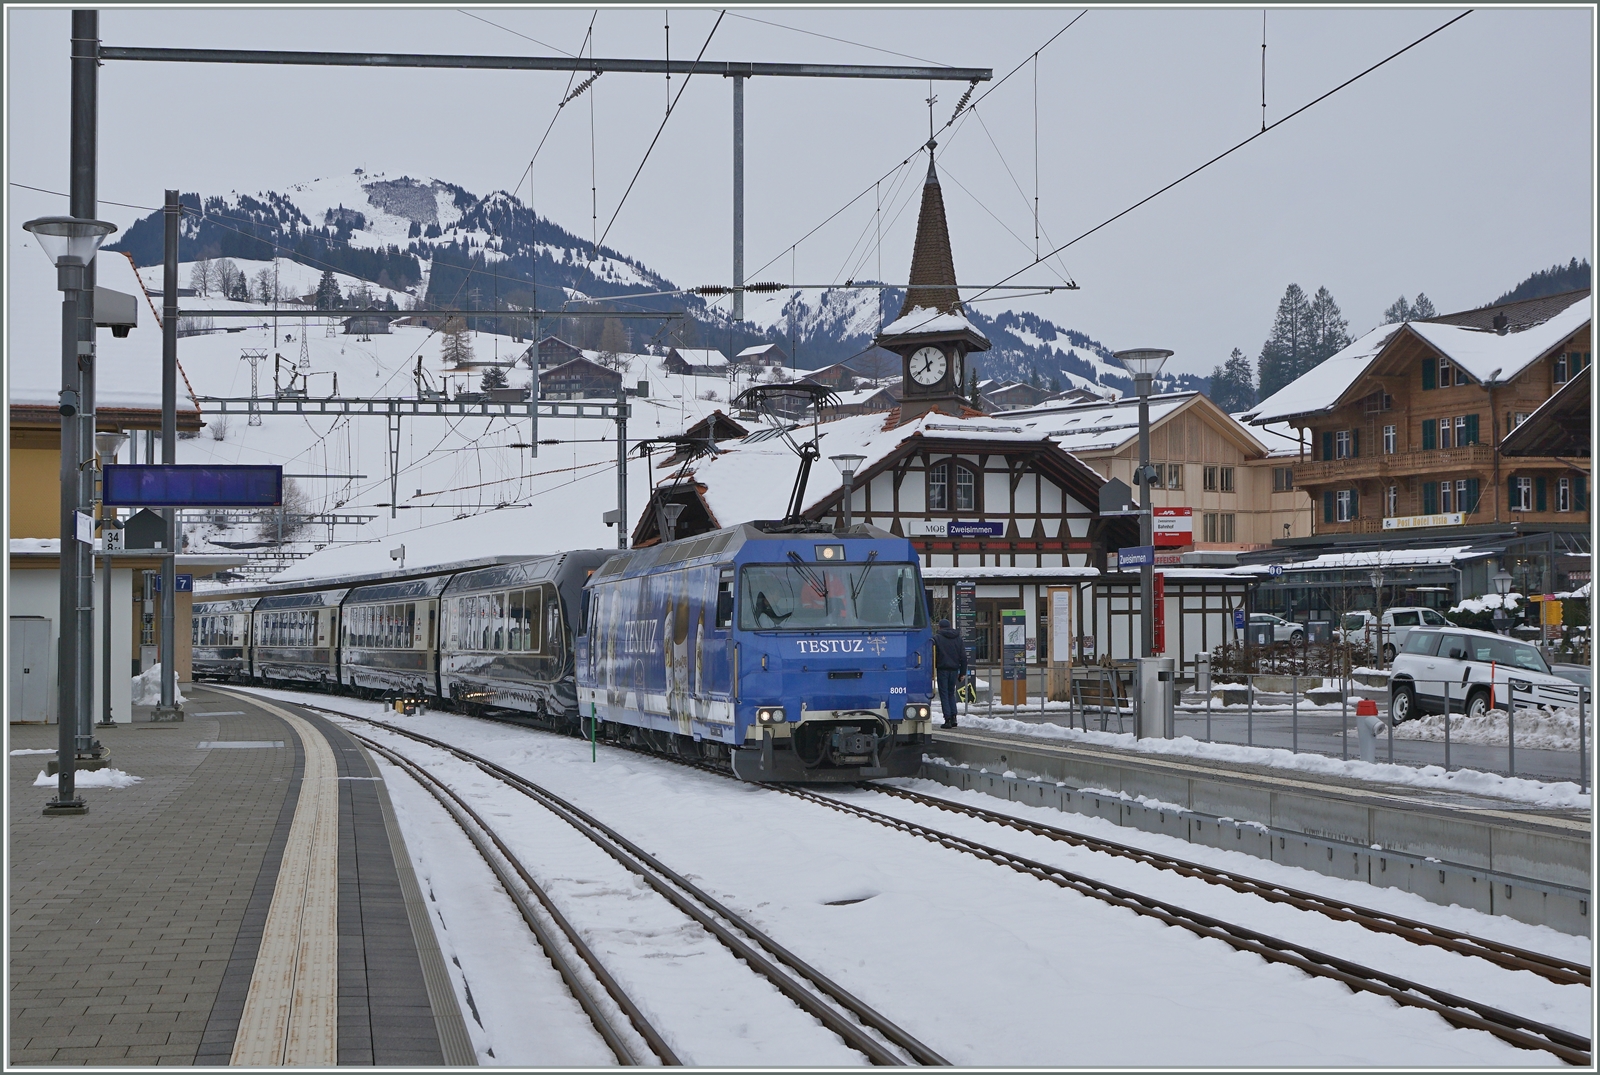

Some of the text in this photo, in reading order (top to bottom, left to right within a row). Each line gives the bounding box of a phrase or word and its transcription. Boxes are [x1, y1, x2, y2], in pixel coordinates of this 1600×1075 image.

[1397, 516, 1447, 527] Post Hotel Vista
[925, 525, 945, 533] MOB
[950, 526, 992, 534] Zweisimmen
[107, 532, 119, 543] 34
[1119, 554, 1146, 565] Zweisimmen
[180, 579, 187, 589] 7
[624, 619, 658, 653] TESTUZ
[796, 639, 864, 654] TESTUZ
[889, 686, 907, 695] 8001
